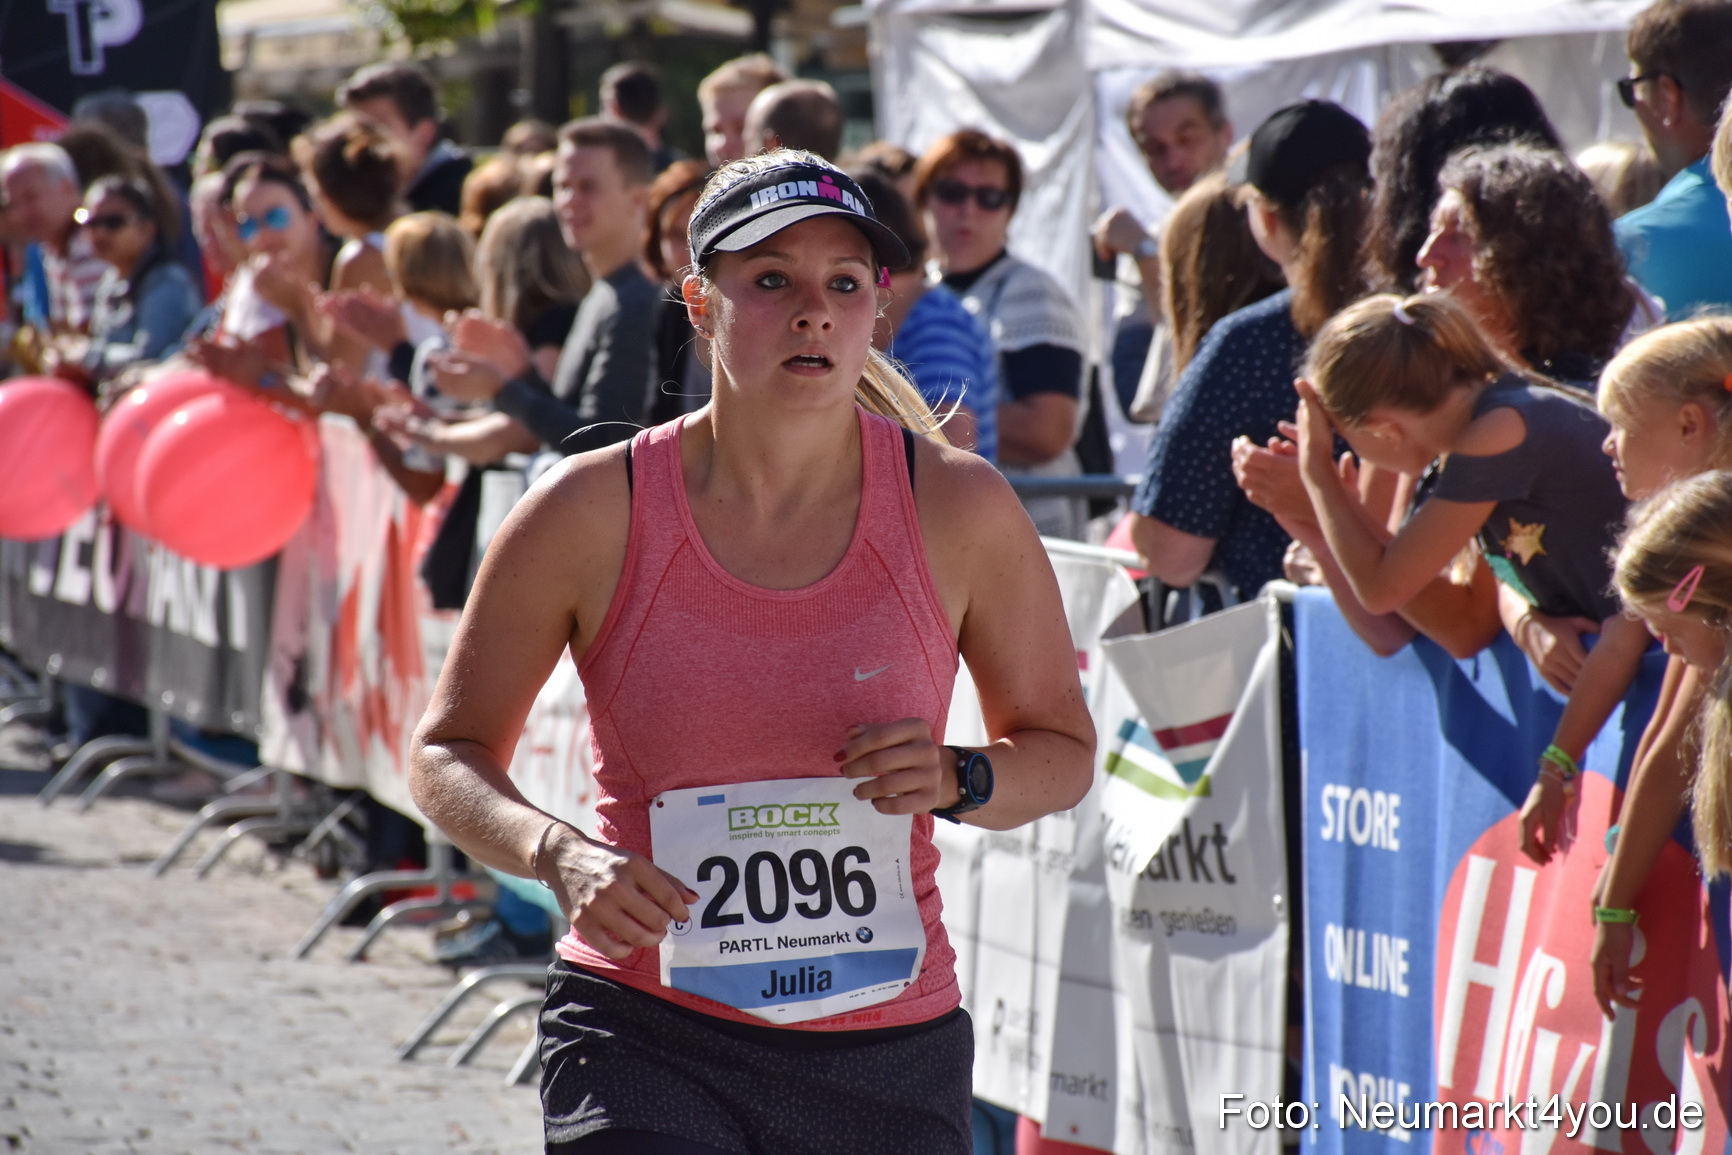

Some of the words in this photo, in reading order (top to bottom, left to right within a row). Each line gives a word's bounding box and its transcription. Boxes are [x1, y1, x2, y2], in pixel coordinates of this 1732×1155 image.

[750, 175, 866, 216] IRONMAN
[728, 803, 840, 832] BOCK
[729, 831, 763, 841] inspired
[765, 830, 774, 839] by
[777, 829, 801, 838] smart
[803, 828, 840, 838] concepts
[1321, 783, 1400, 852] STORE
[696, 846, 877, 929] 2096
[719, 938, 773, 954] PARTL
[777, 931, 851, 949] Neumarkt
[1324, 922, 1409, 998] ONLINE
[761, 965, 832, 999] Julia
